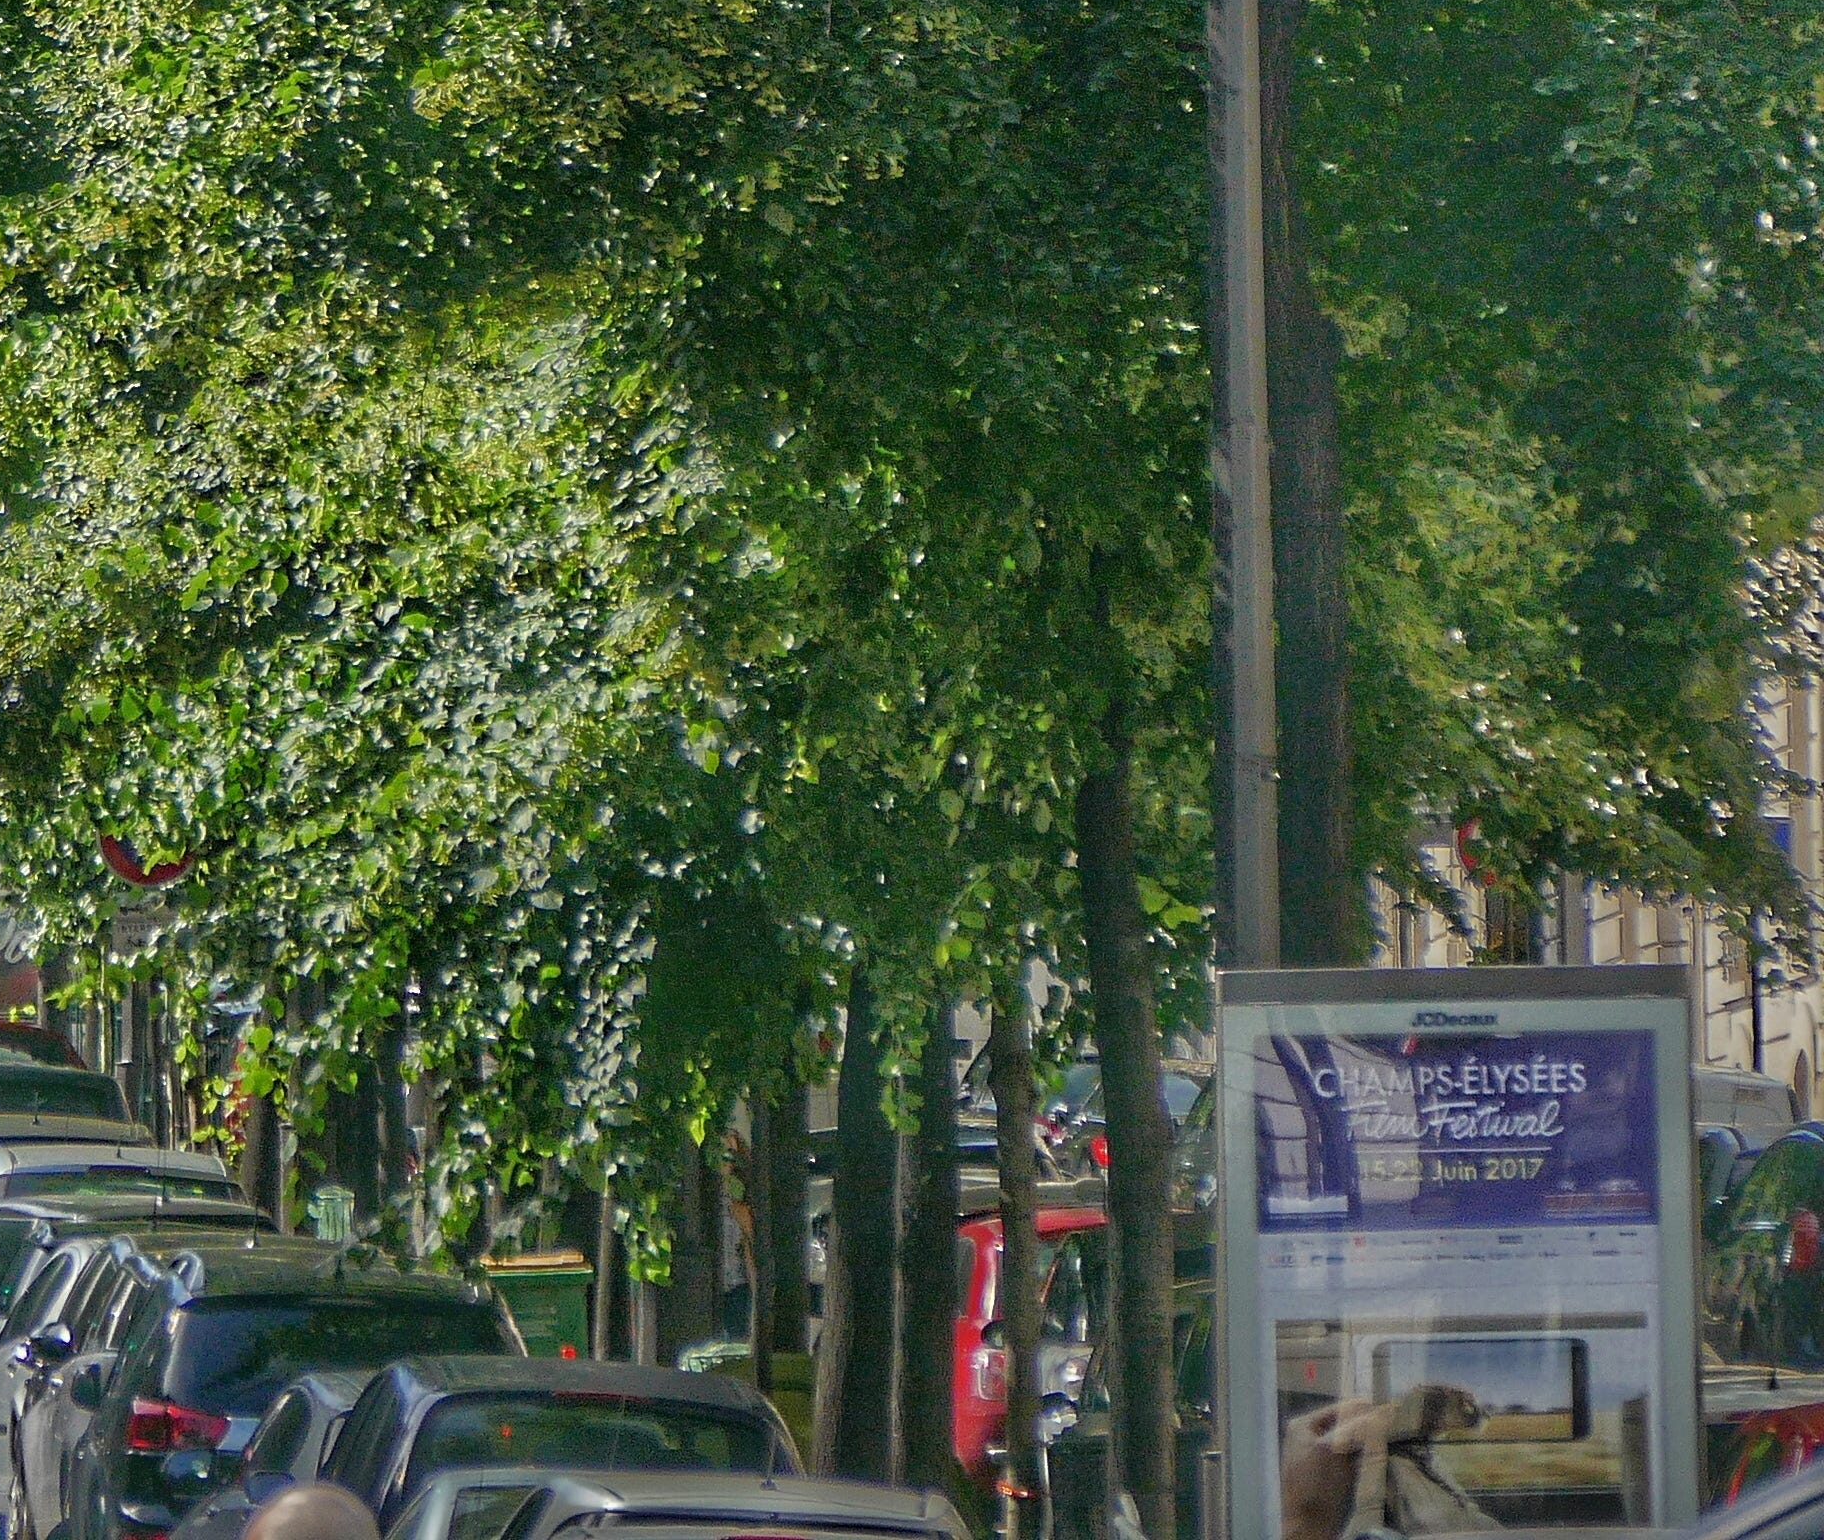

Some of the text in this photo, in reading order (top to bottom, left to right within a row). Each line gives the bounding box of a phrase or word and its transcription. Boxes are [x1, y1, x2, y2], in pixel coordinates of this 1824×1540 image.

[1315, 1055, 1588, 1098] CHAMPS-ÉLYSÉES
[1422, 1099, 1565, 1146] Festival
[1432, 1159, 1477, 1181] Juin
[1485, 1158, 1544, 1180] 2017
